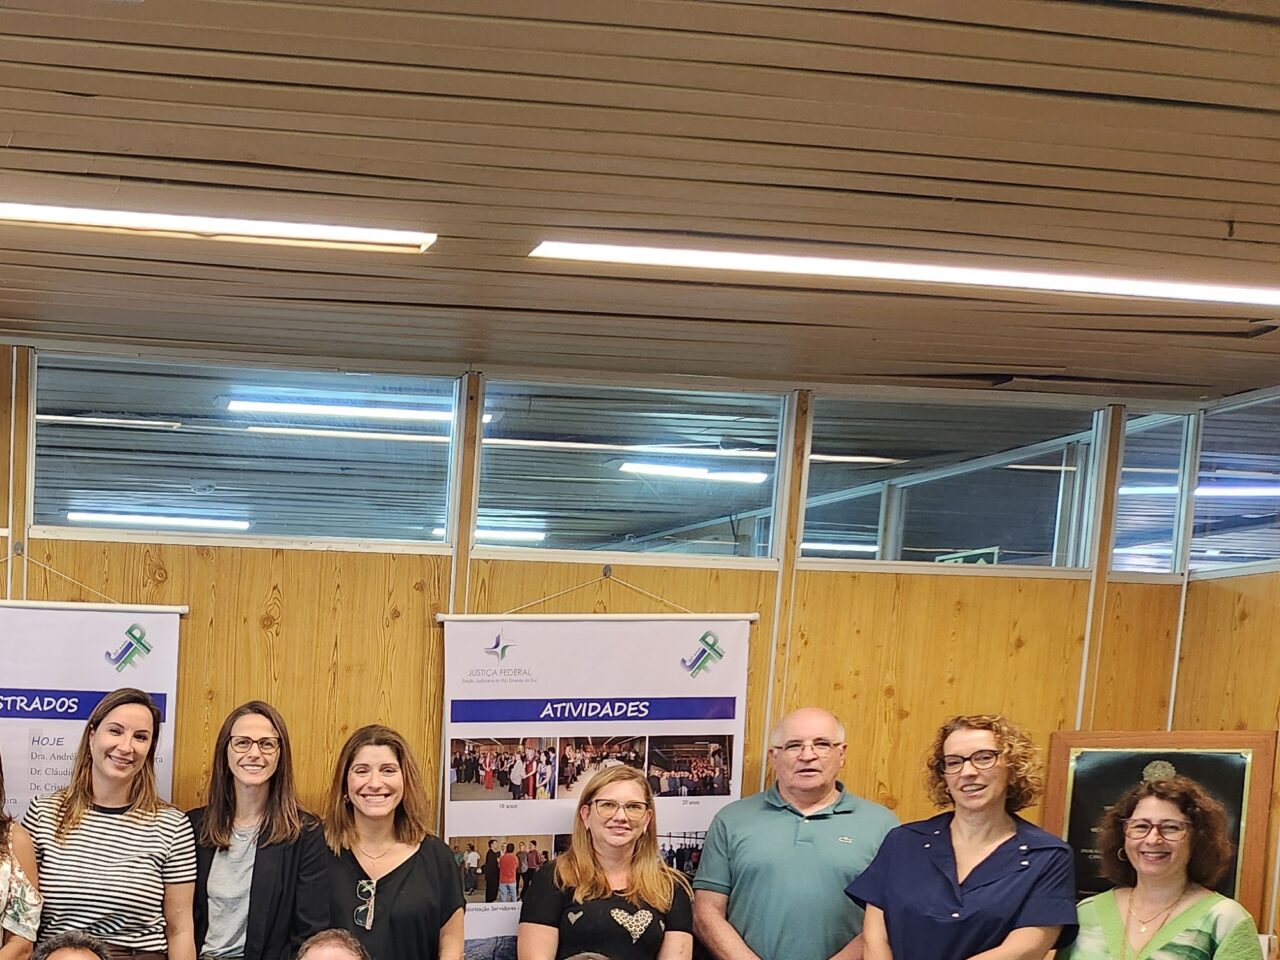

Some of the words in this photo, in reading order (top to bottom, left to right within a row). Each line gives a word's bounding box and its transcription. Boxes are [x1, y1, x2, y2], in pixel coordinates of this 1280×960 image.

[467, 668, 497, 677] JUSTIÇA
[499, 668, 531, 676] FEDERAL
[540, 701, 650, 718] ATIVIDADES
[31, 736, 65, 746] HOJE
[30, 752, 48, 760] Dra.
[30, 767, 42, 775] Dr.
